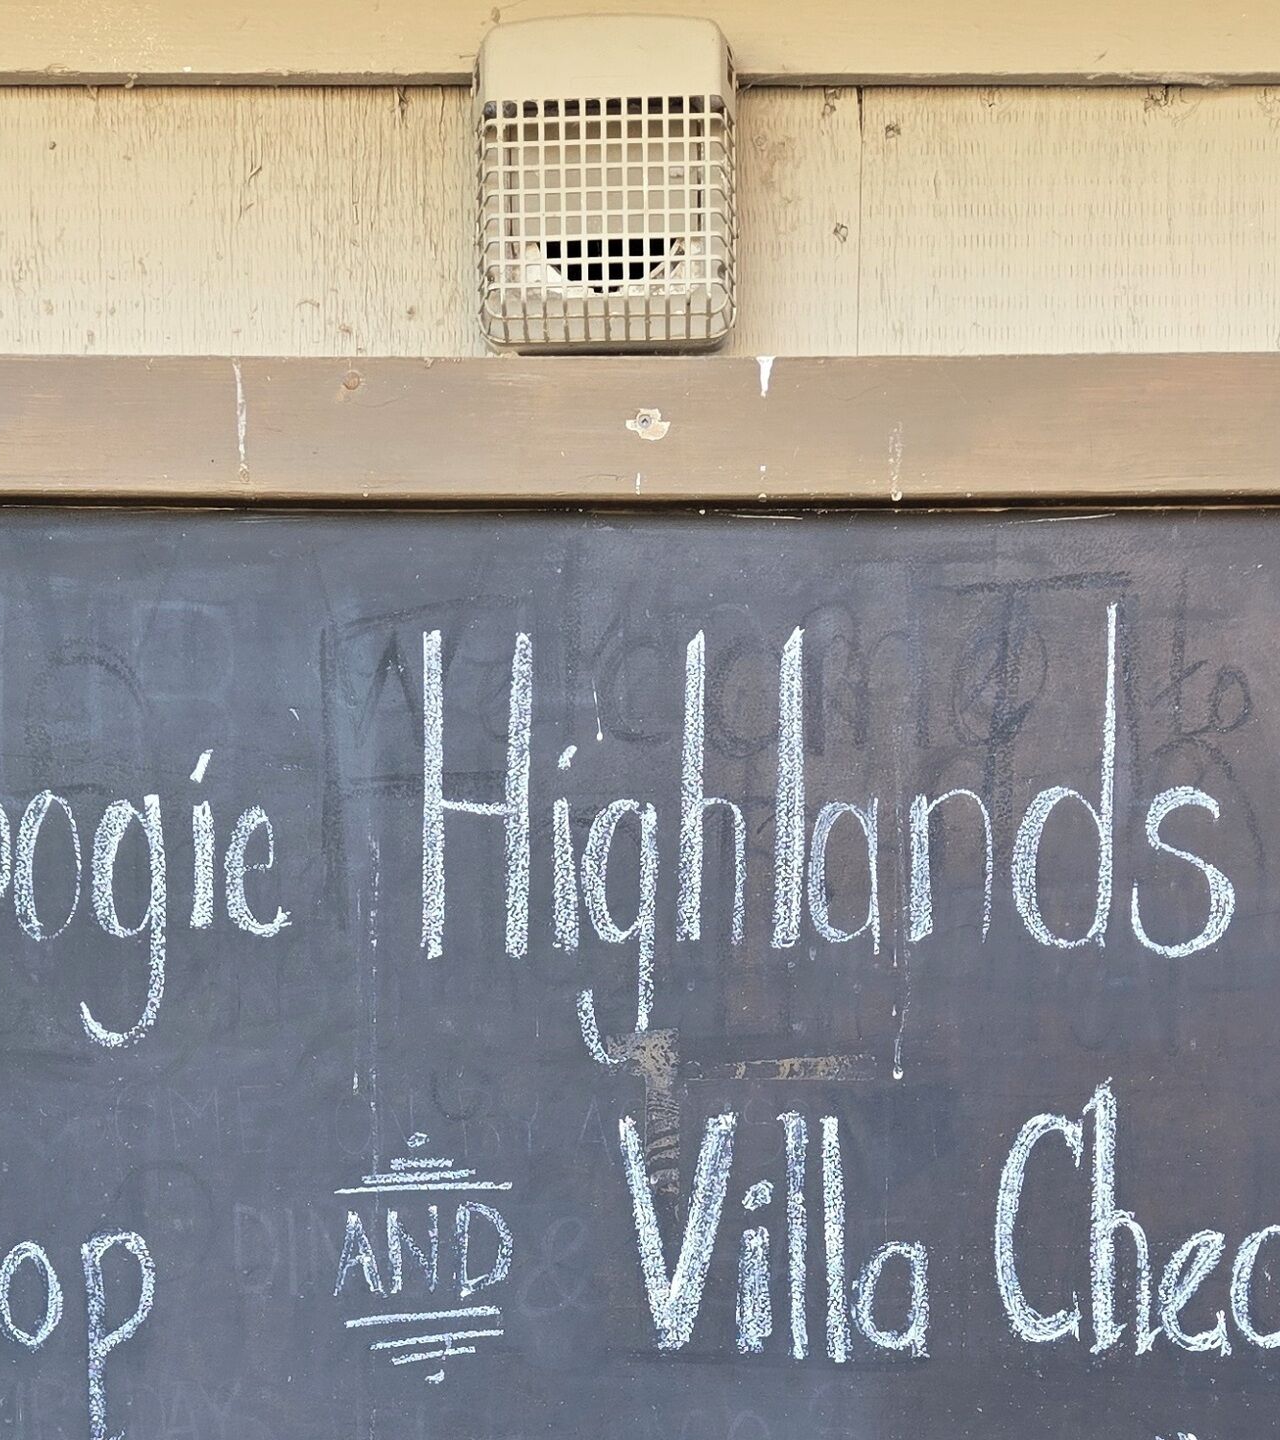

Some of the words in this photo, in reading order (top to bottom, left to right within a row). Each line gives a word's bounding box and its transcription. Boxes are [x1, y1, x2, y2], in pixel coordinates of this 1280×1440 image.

[420, 602, 1235, 1066] Highlands
[333, 1201, 514, 1300] AND
[618, 1110, 931, 1364] Villa
